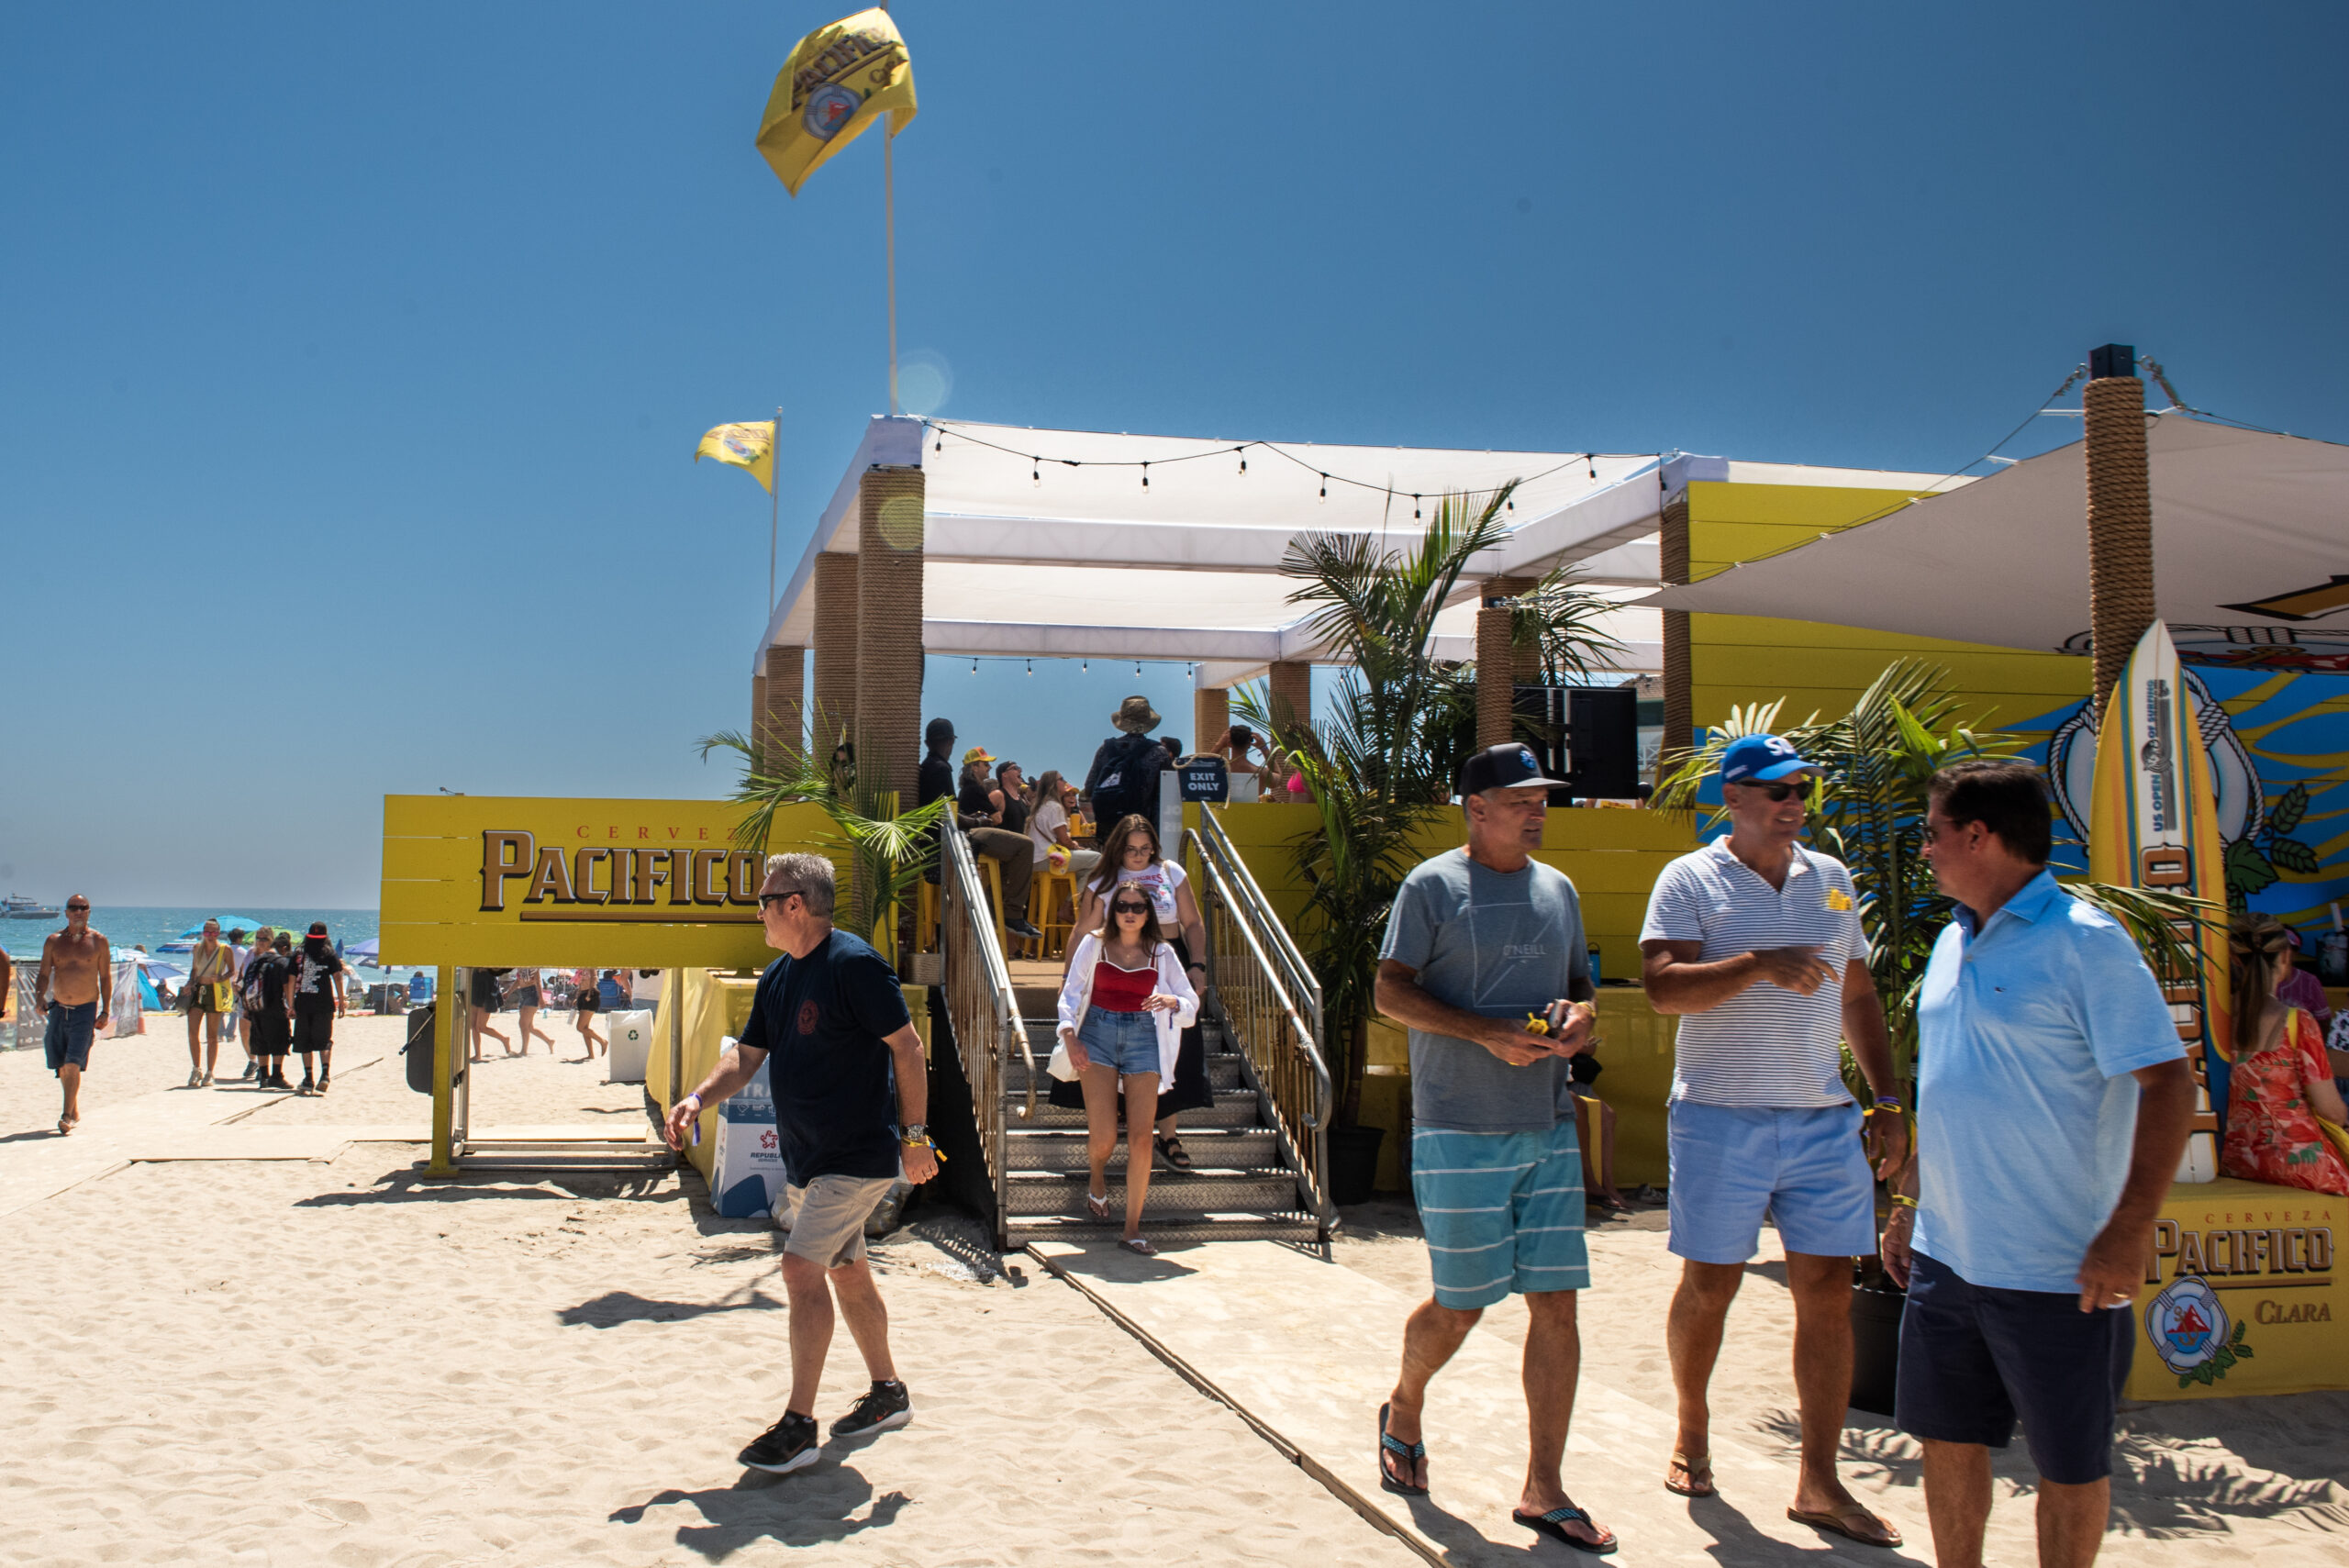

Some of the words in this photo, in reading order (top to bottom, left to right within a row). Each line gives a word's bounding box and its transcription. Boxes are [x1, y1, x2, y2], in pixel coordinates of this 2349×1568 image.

[2147, 725, 2157, 739] OF
[1189, 773, 1216, 781] EXIT
[1187, 783, 1219, 791] ONLY
[2150, 773, 2164, 811] OPEN
[2153, 813, 2165, 832] US
[576, 825, 766, 840] CERVEZ
[478, 829, 769, 912] PACIFICO
[1502, 943, 1548, 956] O'NEILL
[2205, 1210, 2332, 1225] CERVEZA
[2145, 1218, 2334, 1284] PACIFICO
[2254, 1299, 2332, 1325] CLARA
